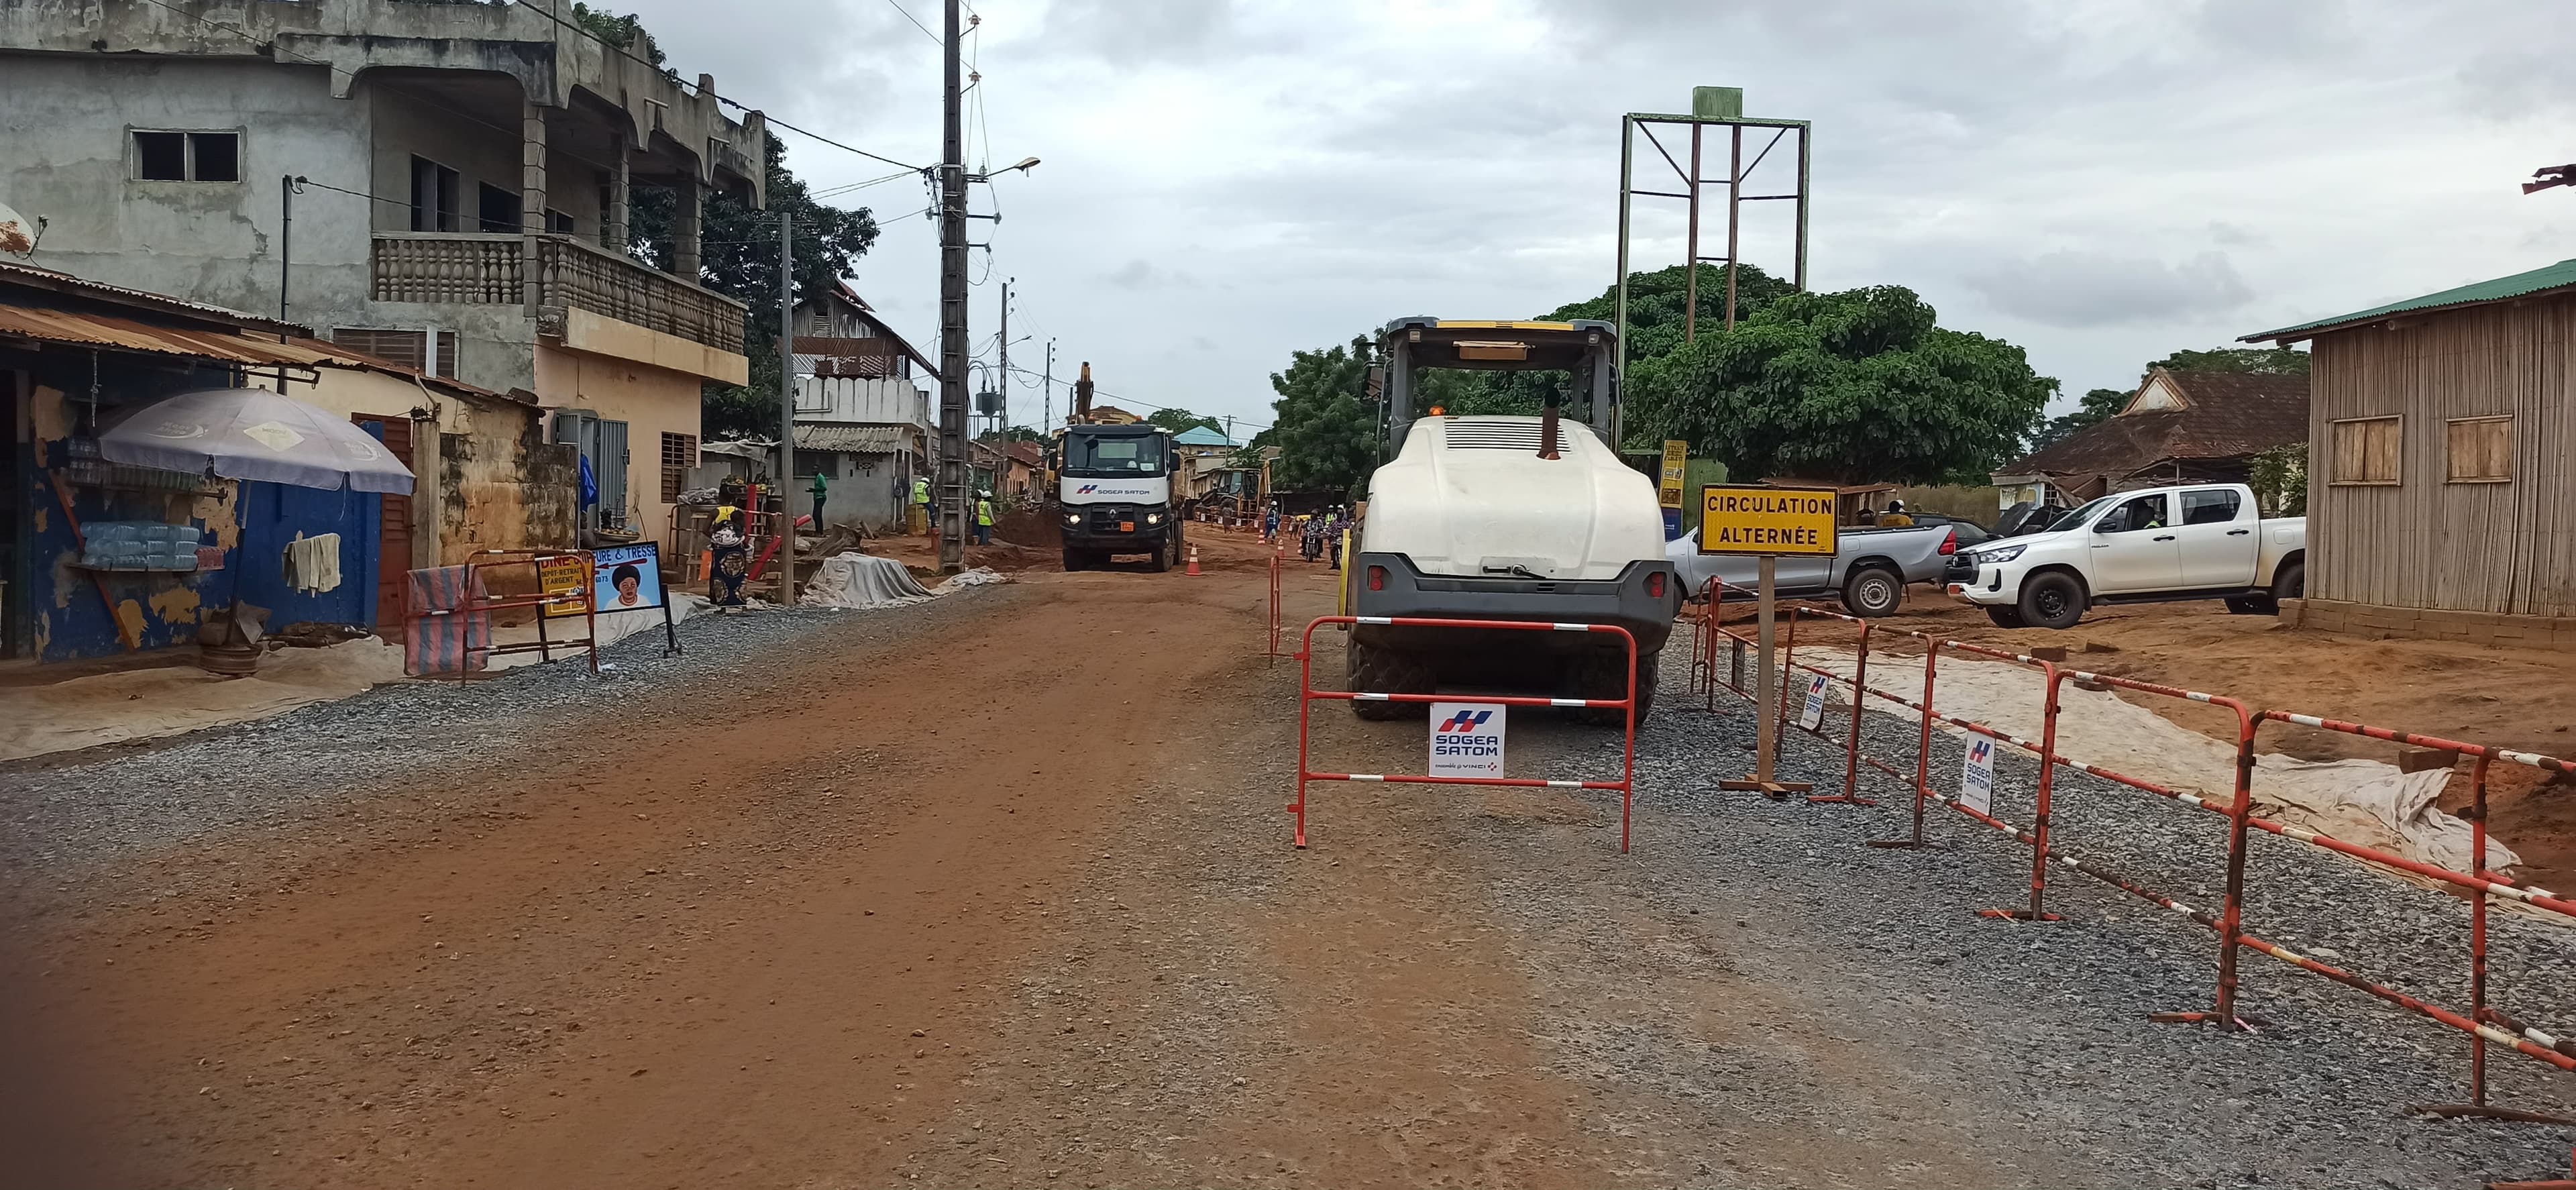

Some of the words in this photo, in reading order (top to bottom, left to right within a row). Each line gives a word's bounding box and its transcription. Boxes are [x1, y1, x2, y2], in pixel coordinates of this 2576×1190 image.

[1707, 496, 1832, 515] CIRCULATION
[1720, 525, 1817, 545] ALTERNÉE
[615, 549, 623, 560] &
[1807, 694, 1823, 706] SOGEA
[1436, 735, 1498, 745] SOGEA
[1436, 746, 1498, 756] SATOM
[1967, 763, 1990, 781] SOGEA
[1966, 774, 1990, 792] SATOM
